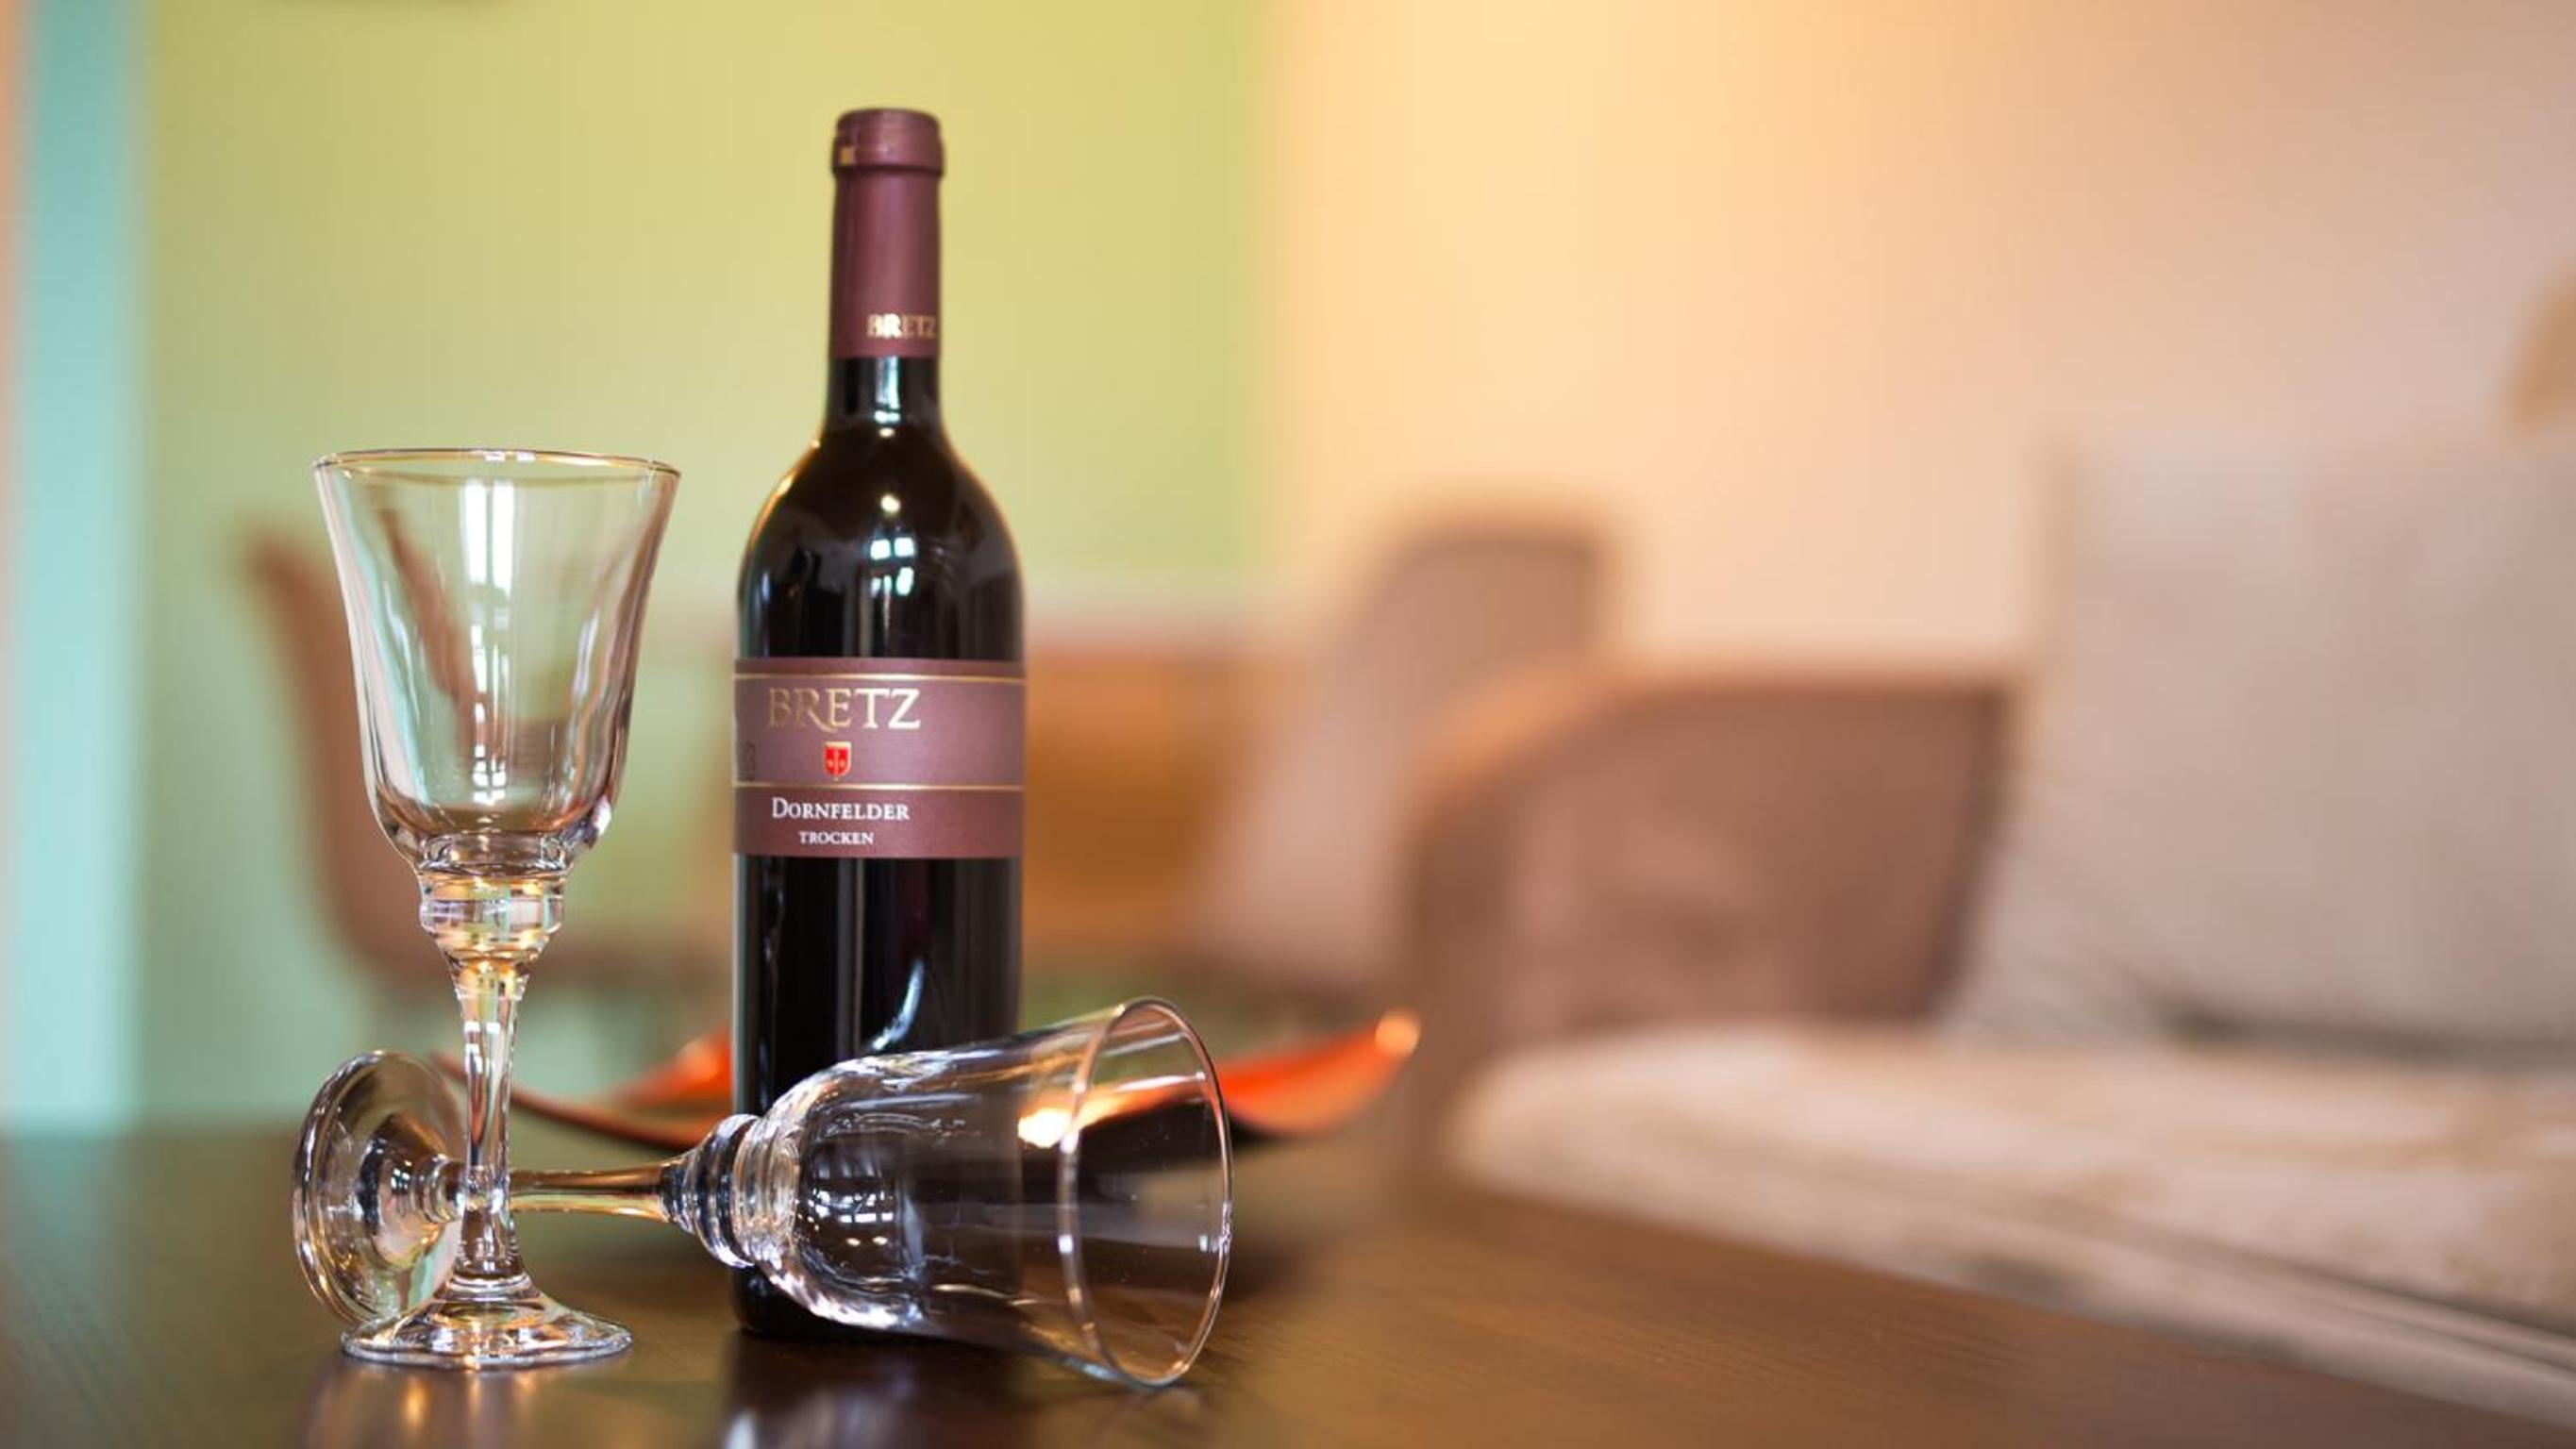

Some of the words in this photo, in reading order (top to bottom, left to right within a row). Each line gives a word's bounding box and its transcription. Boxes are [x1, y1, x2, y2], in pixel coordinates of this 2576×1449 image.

[867, 313, 936, 338] BRETZ
[769, 688, 921, 733] BRETZ
[771, 797, 910, 821] DORNFELDER
[799, 831, 875, 845] TROCKEN
